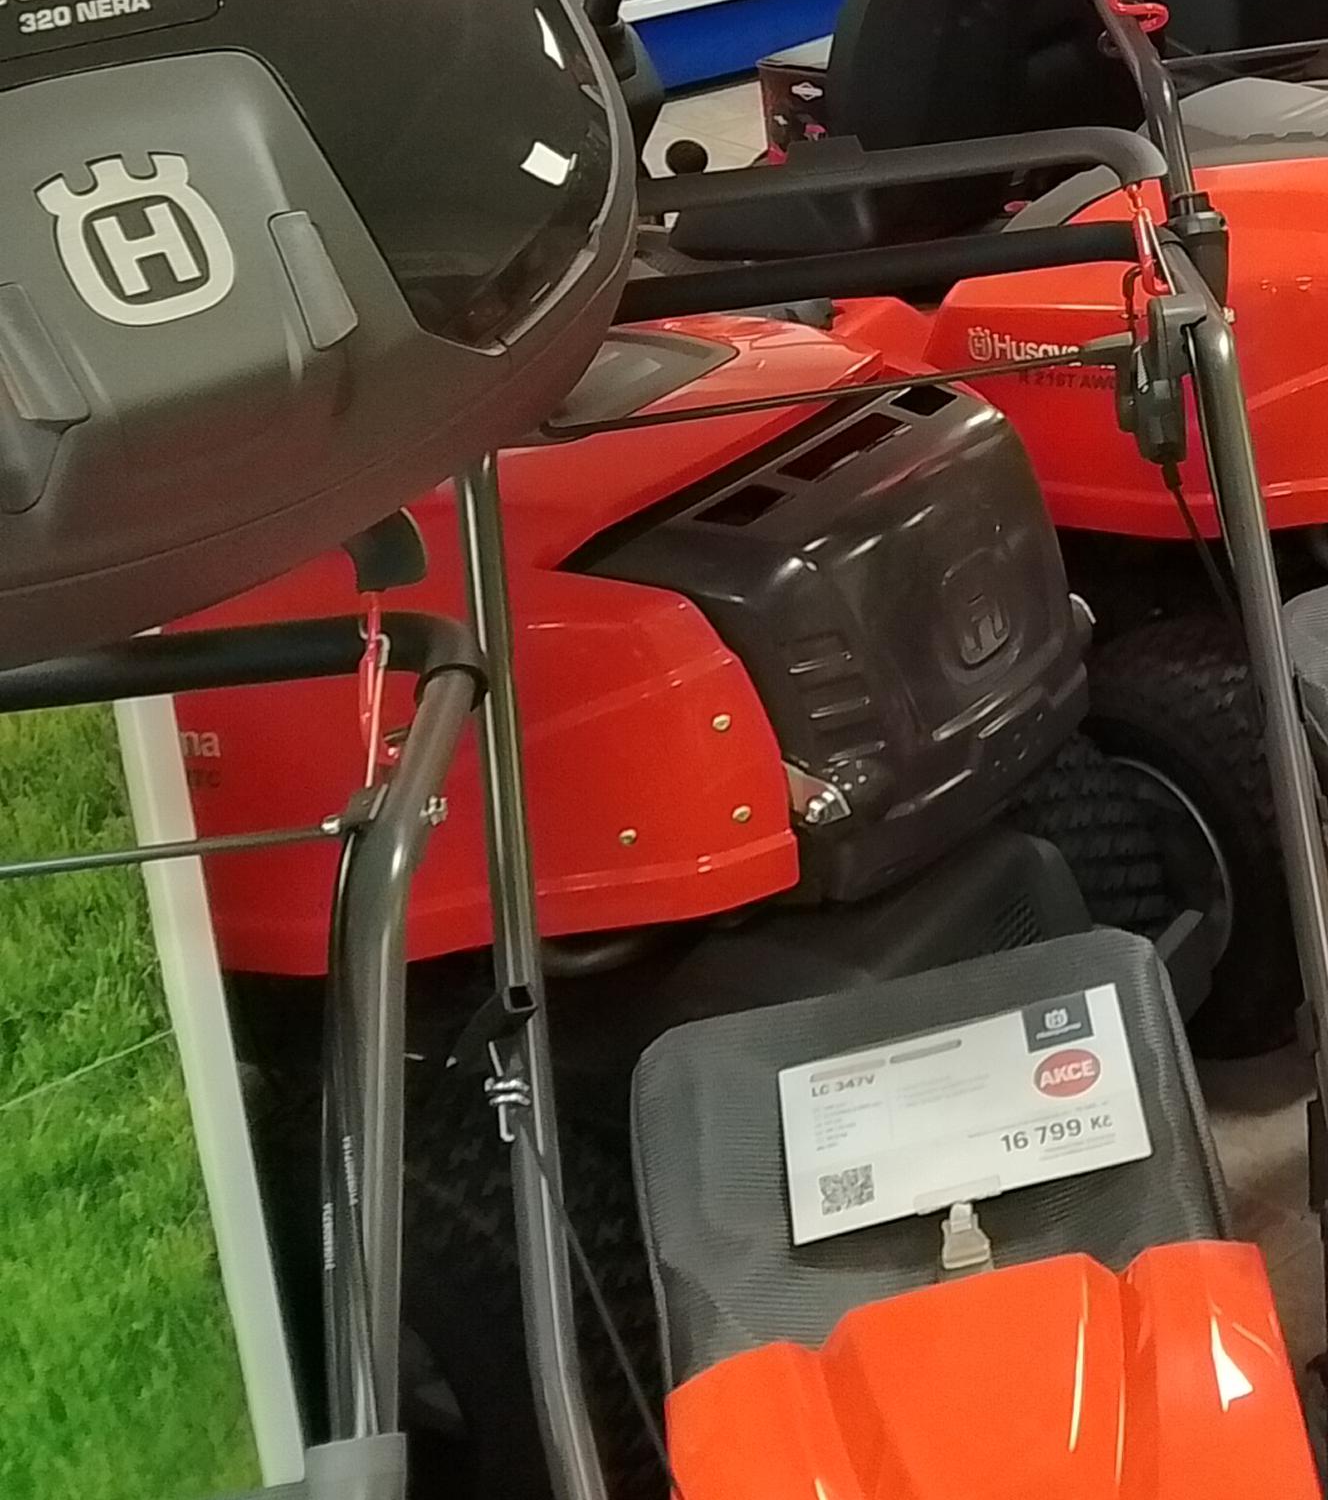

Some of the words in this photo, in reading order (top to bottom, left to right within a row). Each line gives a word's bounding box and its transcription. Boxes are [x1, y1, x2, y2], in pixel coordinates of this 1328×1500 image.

[19, 5, 72, 34] 320
[811, 1085, 829, 1098] LC
[836, 1074, 876, 1094] 347V
[1040, 1059, 1096, 1089] AKCE
[1000, 1133, 1029, 1152] 16
[1034, 1118, 1082, 1146] 799
[1090, 1114, 1114, 1130] Kč
